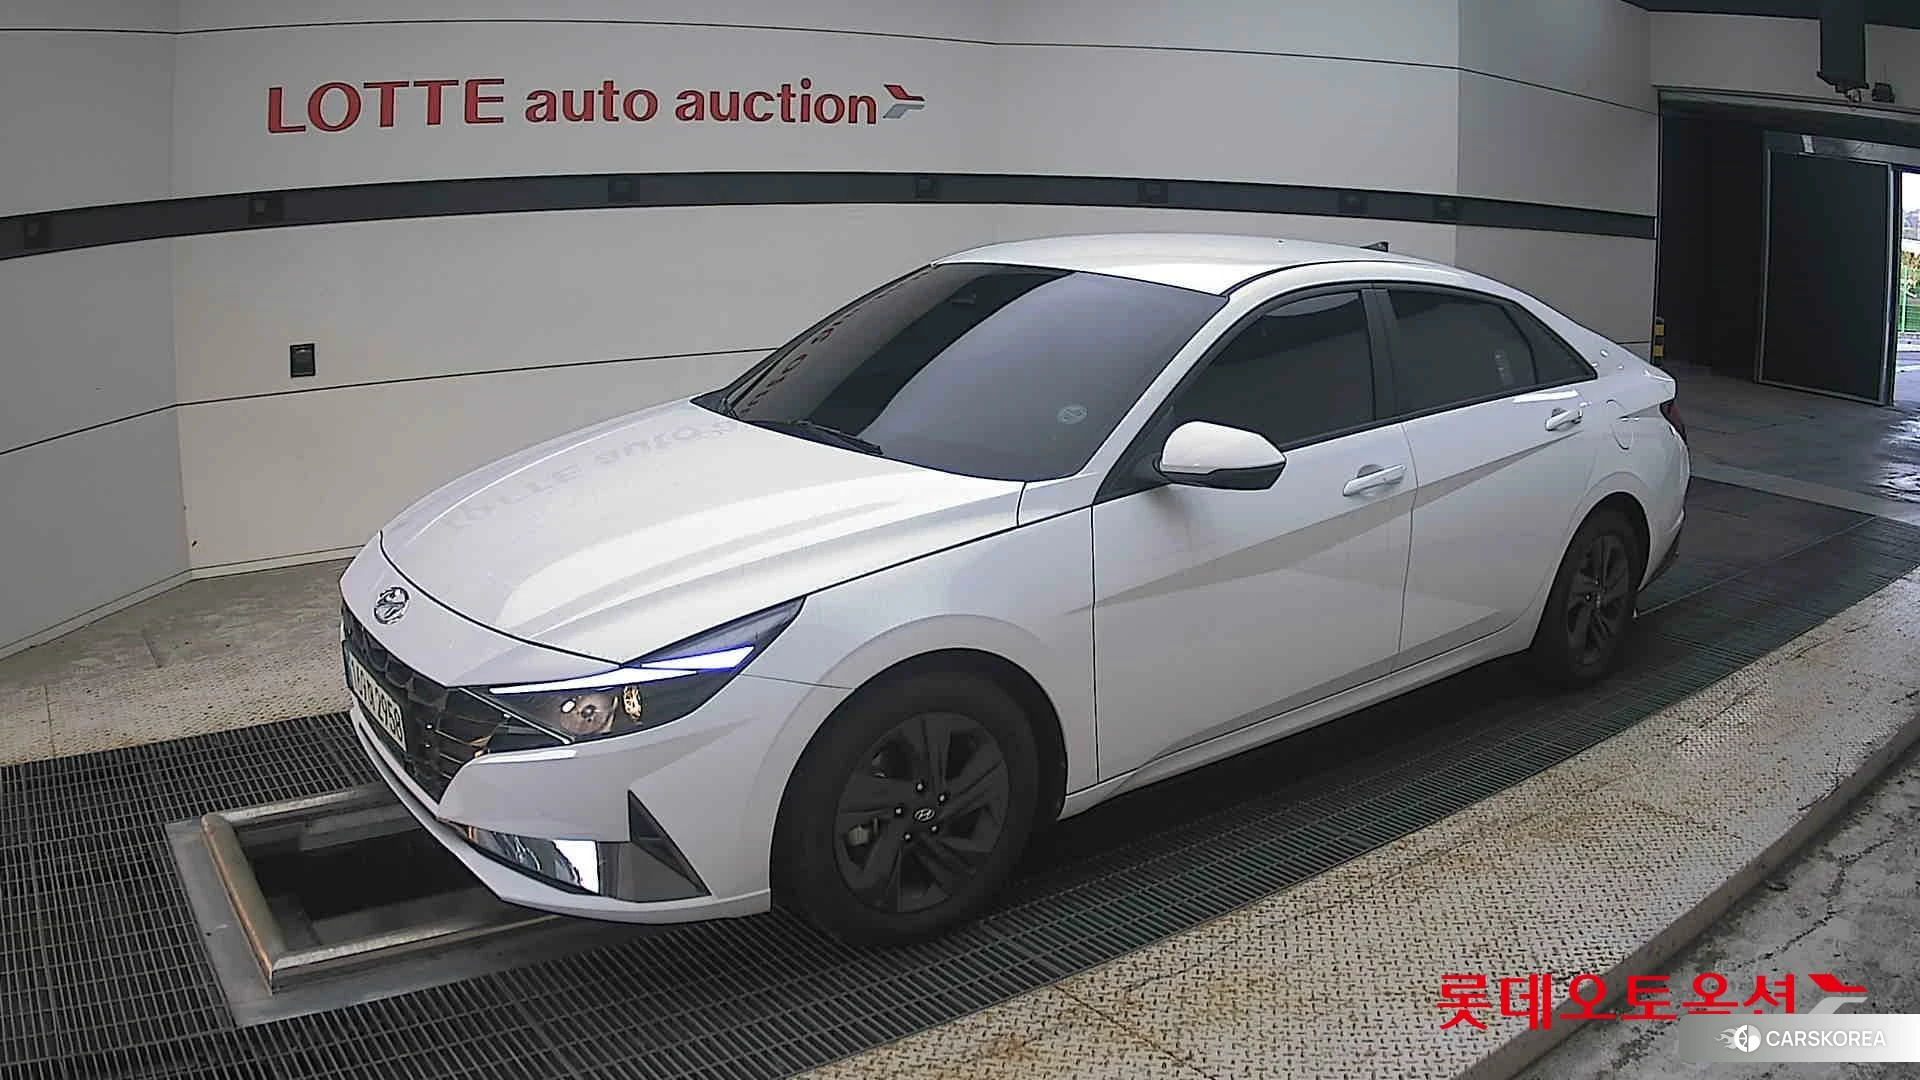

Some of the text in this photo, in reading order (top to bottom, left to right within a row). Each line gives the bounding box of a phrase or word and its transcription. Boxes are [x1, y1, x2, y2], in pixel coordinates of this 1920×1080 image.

[267, 79, 877, 133] LOTTE auto auction
